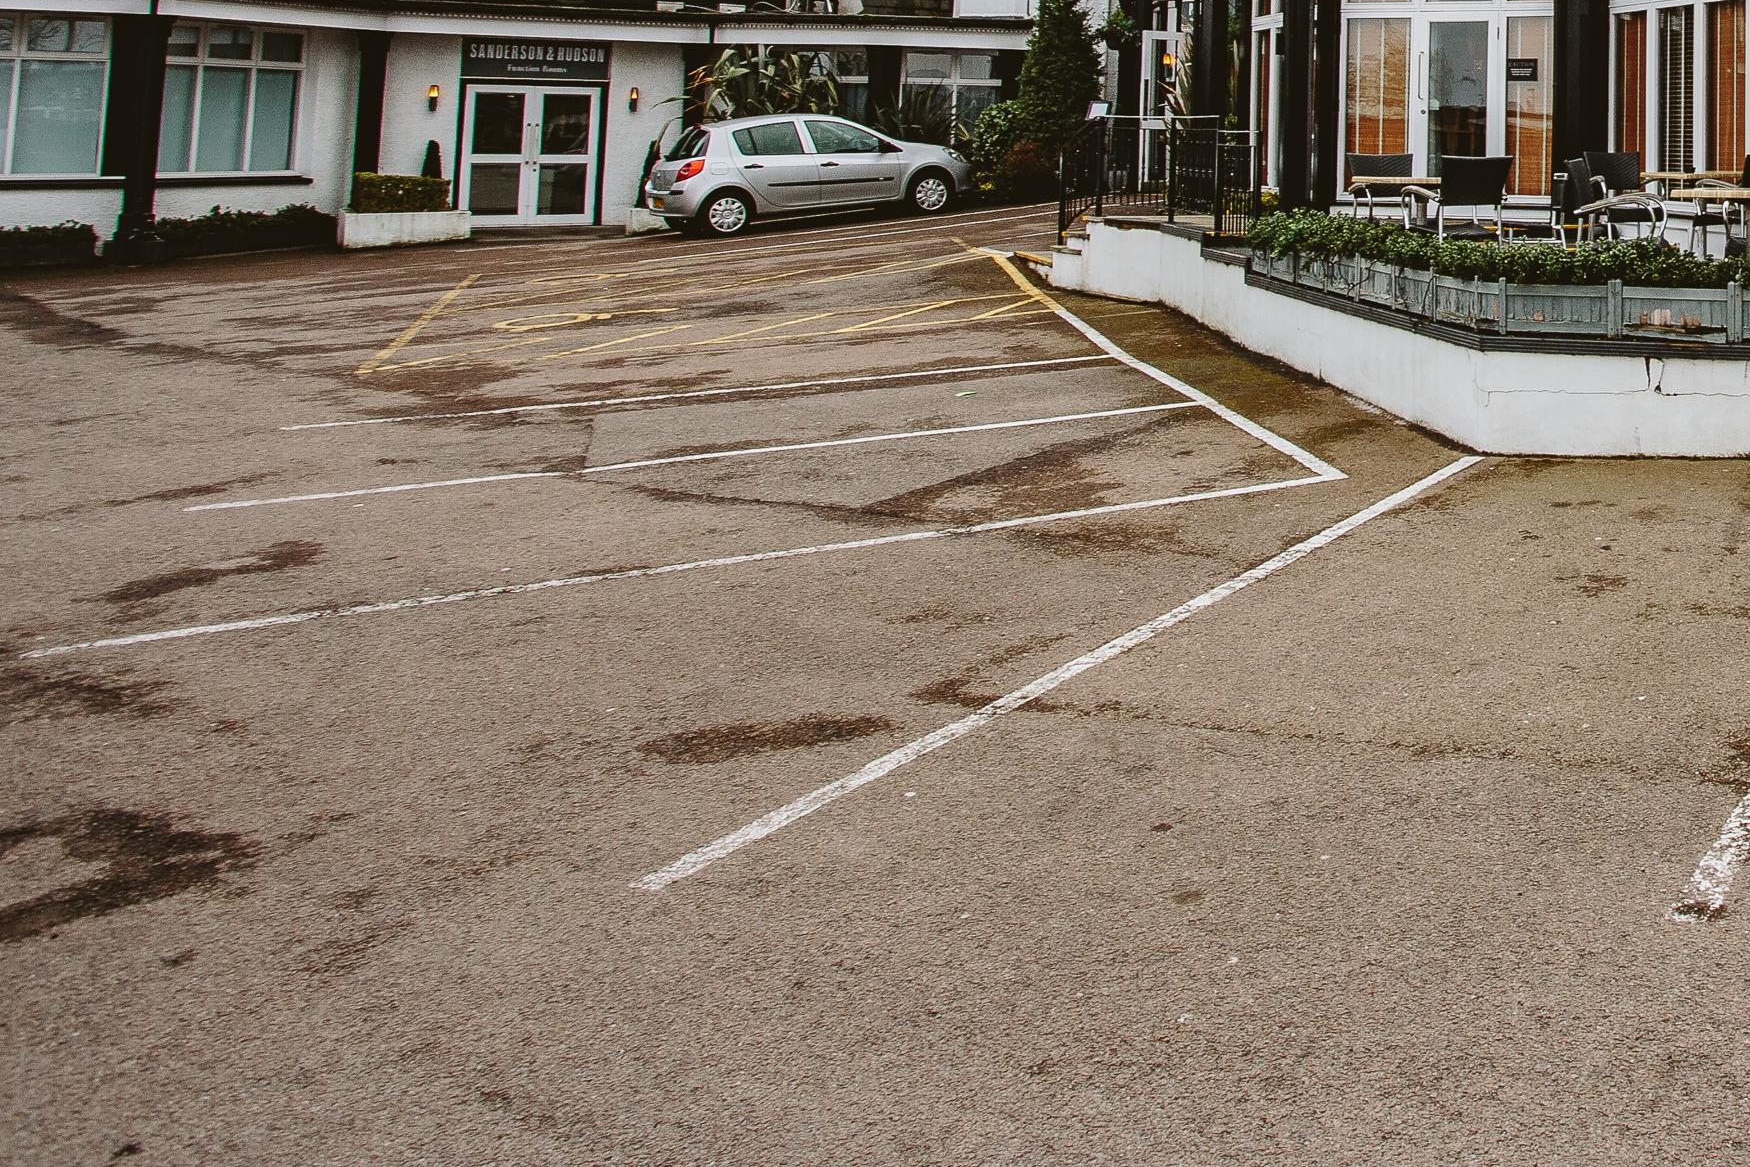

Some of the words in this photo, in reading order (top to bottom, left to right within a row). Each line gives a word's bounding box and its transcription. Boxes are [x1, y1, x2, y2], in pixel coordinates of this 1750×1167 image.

[470, 43, 544, 60] SANDERSON
[546, 46, 555, 61] &
[557, 47, 605, 63] HUDSON
